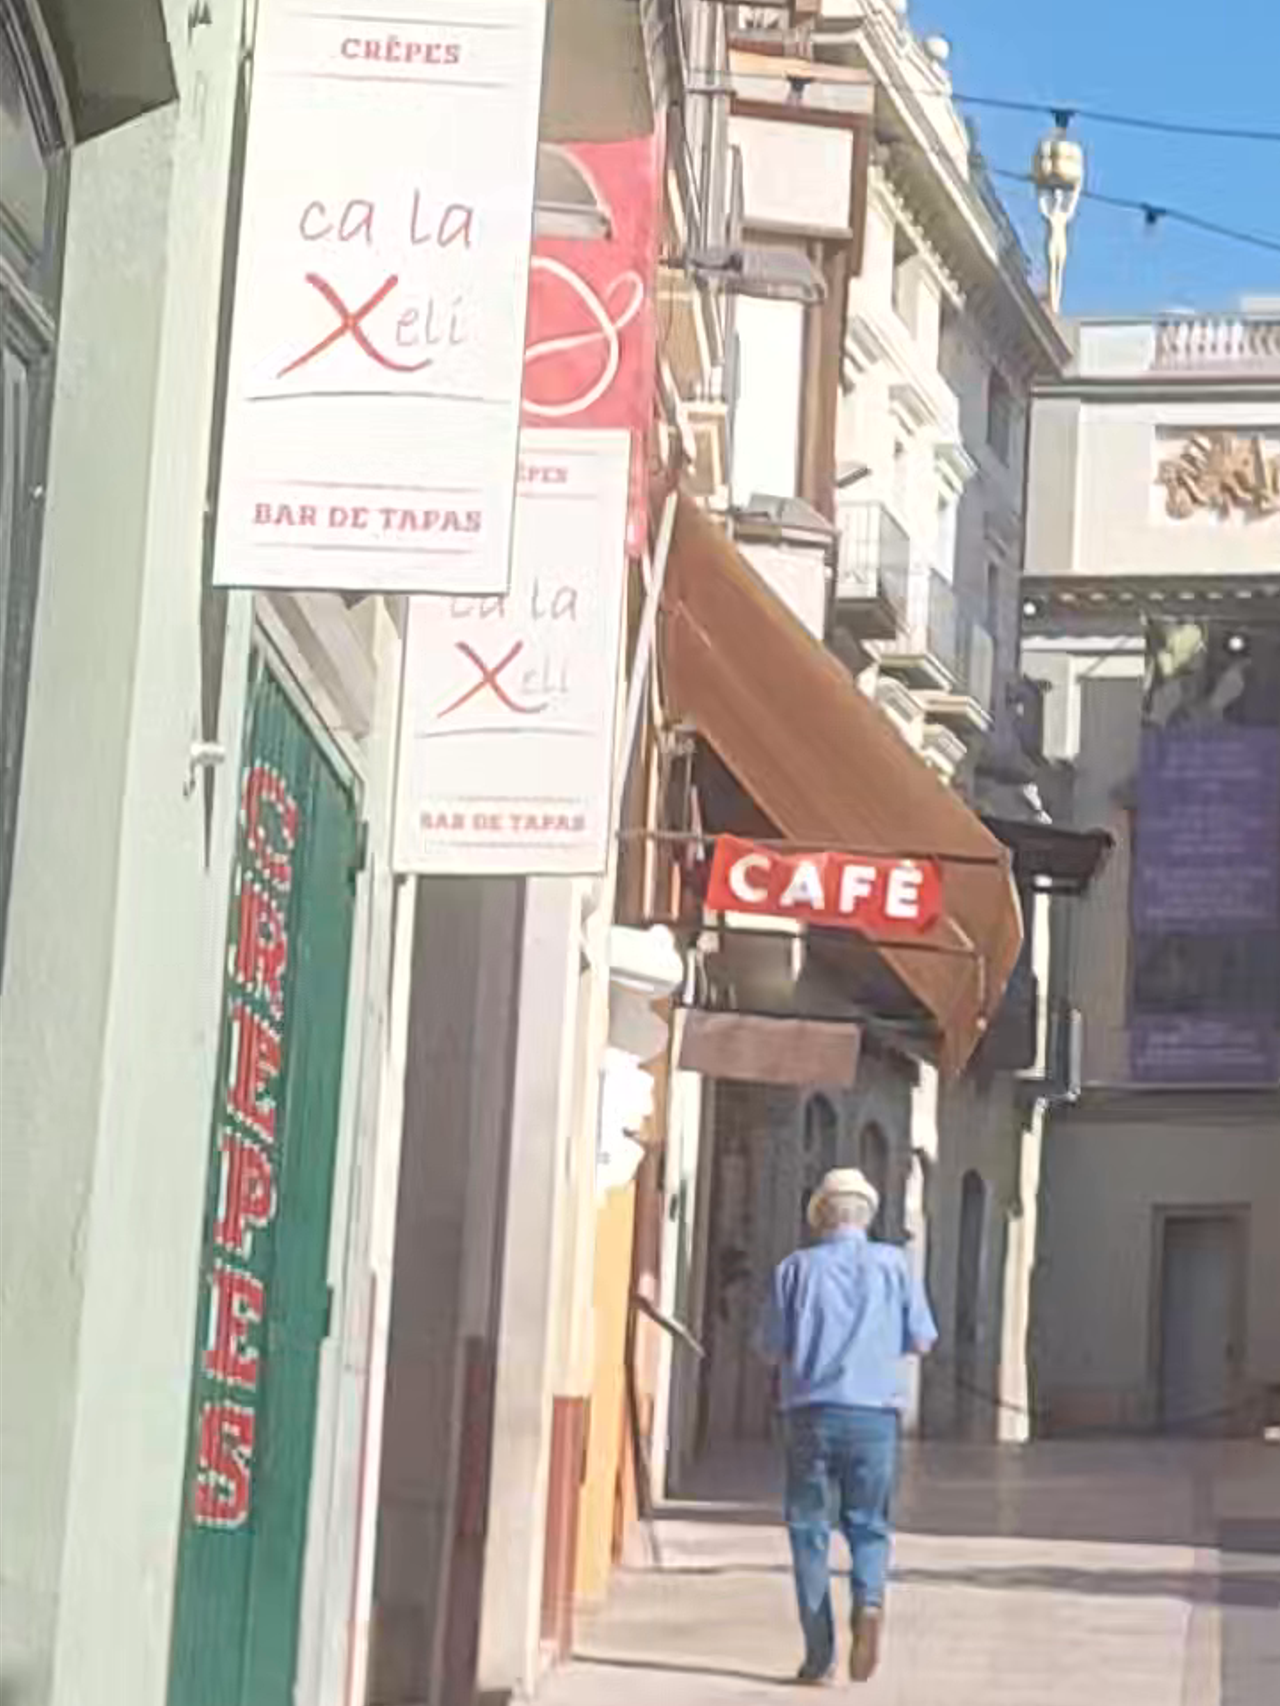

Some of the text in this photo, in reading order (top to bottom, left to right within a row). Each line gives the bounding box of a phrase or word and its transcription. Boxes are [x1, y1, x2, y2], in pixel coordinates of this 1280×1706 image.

[299, 187, 474, 250] ca la
[254, 502, 483, 533] BAR DE TAPAS
[531, 576, 578, 622] la
[419, 811, 586, 833] BAR DE TAPAS
